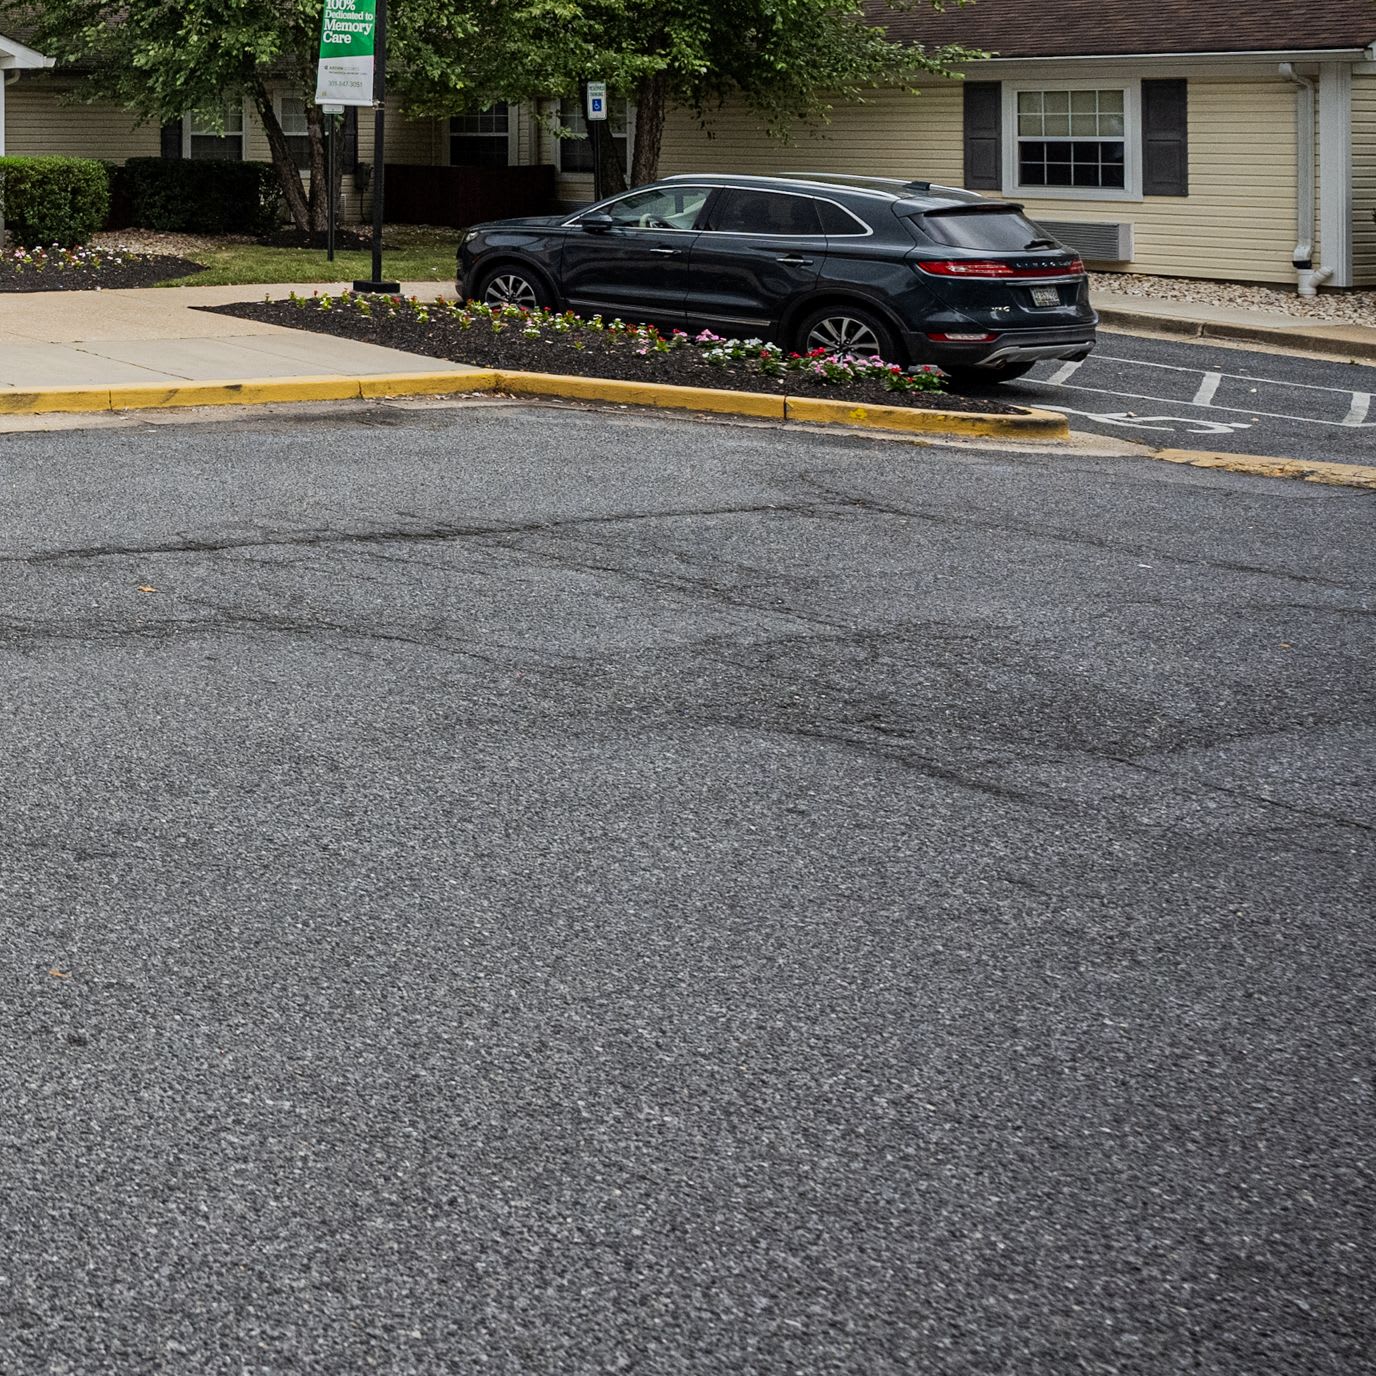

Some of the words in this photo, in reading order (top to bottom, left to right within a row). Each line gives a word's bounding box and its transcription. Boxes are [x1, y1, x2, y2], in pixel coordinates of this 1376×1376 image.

[324, 9, 364, 21] Dedicated
[366, 12, 373, 20] to
[323, 18, 373, 36] Memory
[322, 30, 352, 44] Care
